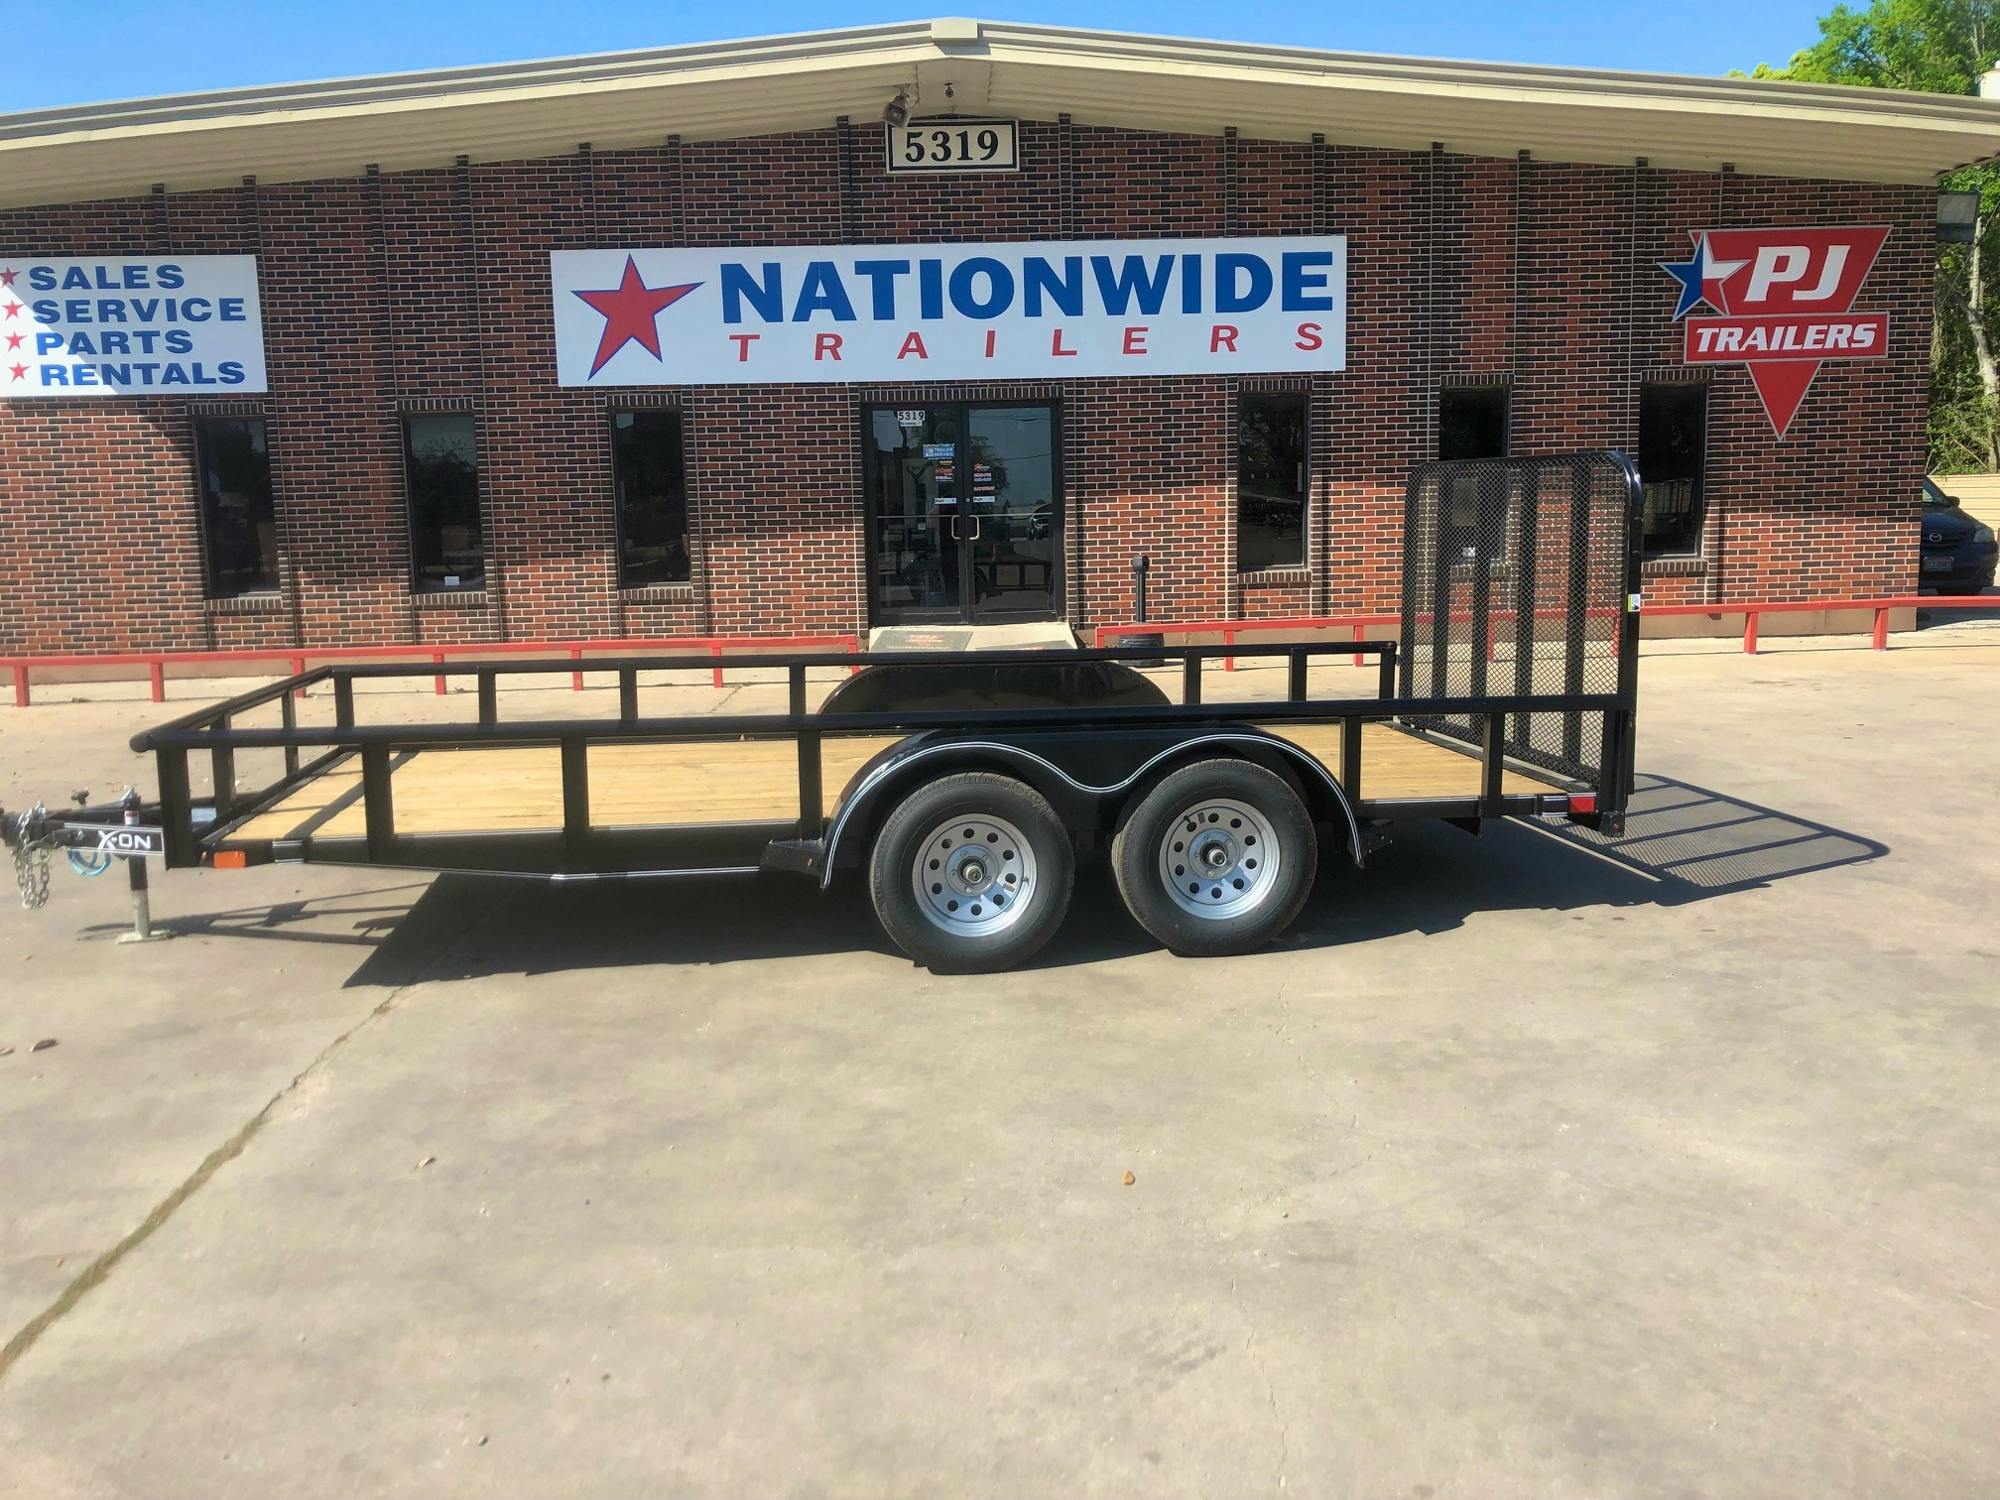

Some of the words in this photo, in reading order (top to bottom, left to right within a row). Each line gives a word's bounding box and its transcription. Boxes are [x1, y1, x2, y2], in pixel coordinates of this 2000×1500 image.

[905, 129, 999, 162] 5319
[29, 264, 185, 291] SALES
[1743, 244, 1851, 302] PJ
[720, 251, 1333, 324] NATIONWIDE
[32, 297, 246, 324] SERVICE
[35, 329, 193, 355] PARTS
[729, 322, 1323, 362] TRAILERS
[1696, 322, 1877, 353] TRAILERS
[40, 361, 245, 386] RENTALS
[898, 411, 925, 421] 5319
[97, 830, 151, 849] X-ON
